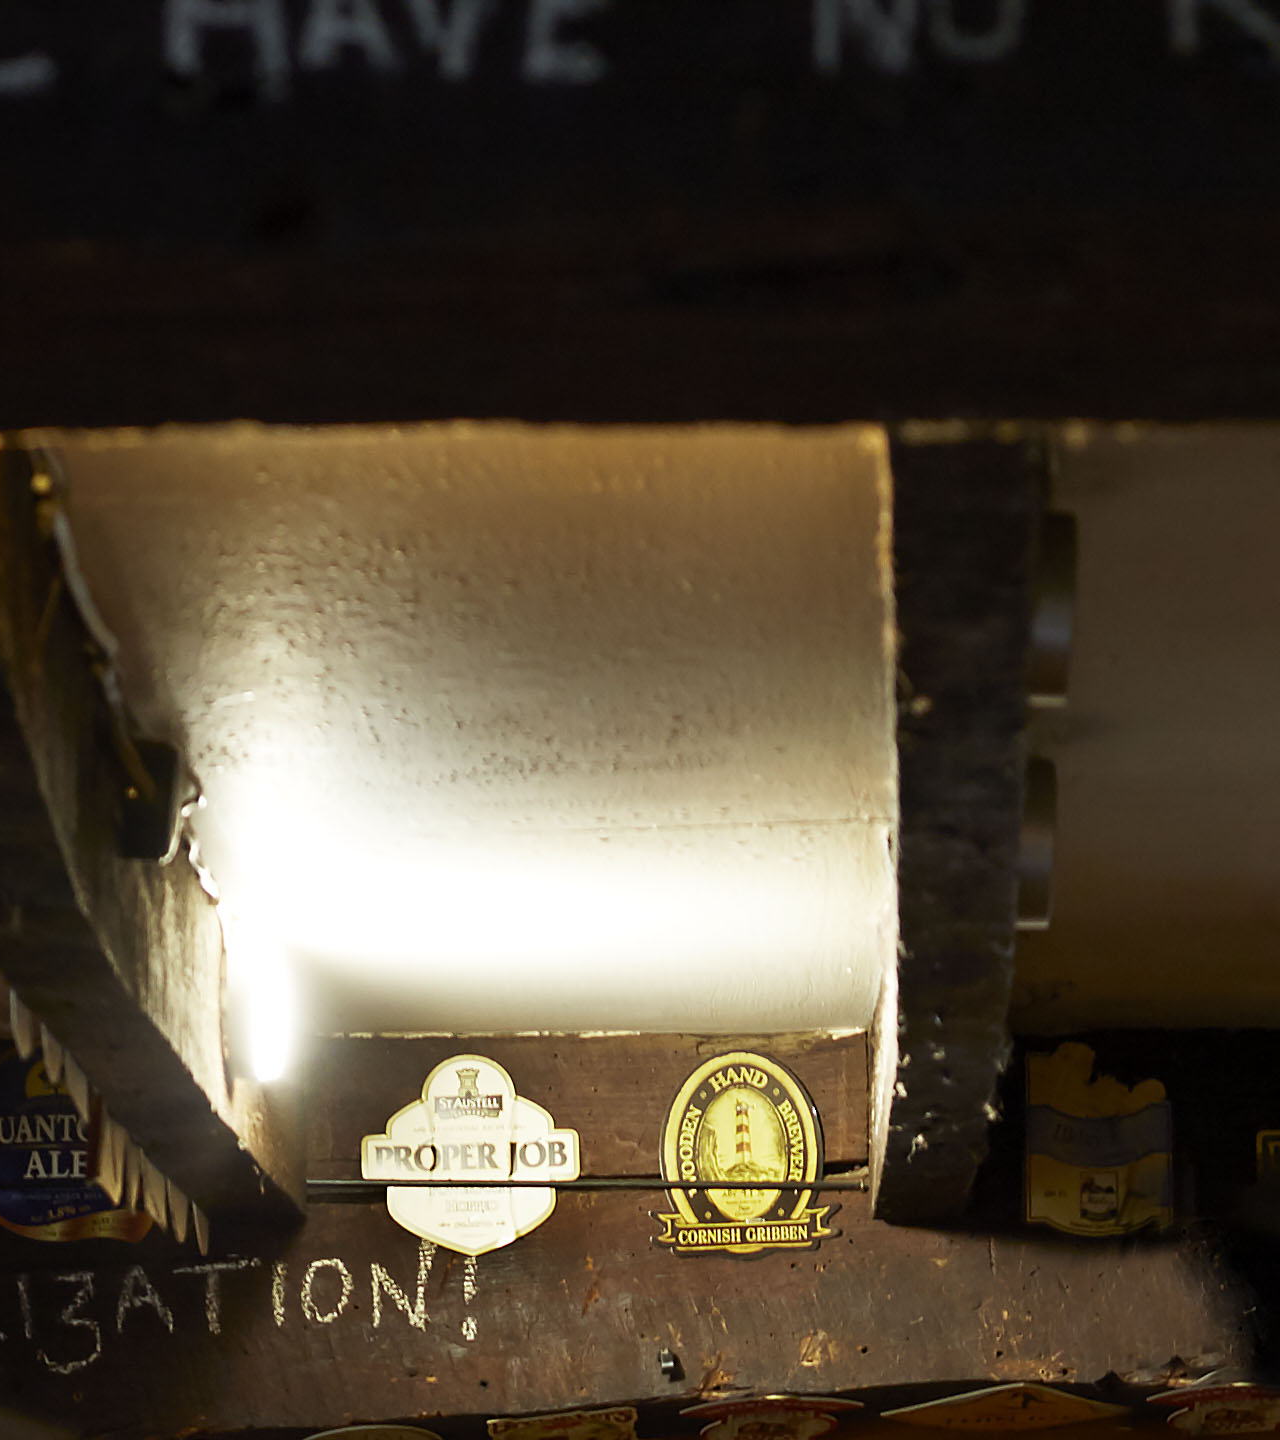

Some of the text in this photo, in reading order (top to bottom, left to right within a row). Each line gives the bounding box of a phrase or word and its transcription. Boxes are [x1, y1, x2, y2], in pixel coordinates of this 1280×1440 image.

[708, 1066, 770, 1094] HAND
[451, 1095, 500, 1111] AUSTELL
[23, 1150, 88, 1180] ALE
[375, 1138, 569, 1179] PROPER JOB
[677, 1223, 810, 1246] CORNISH GRIBBEN
